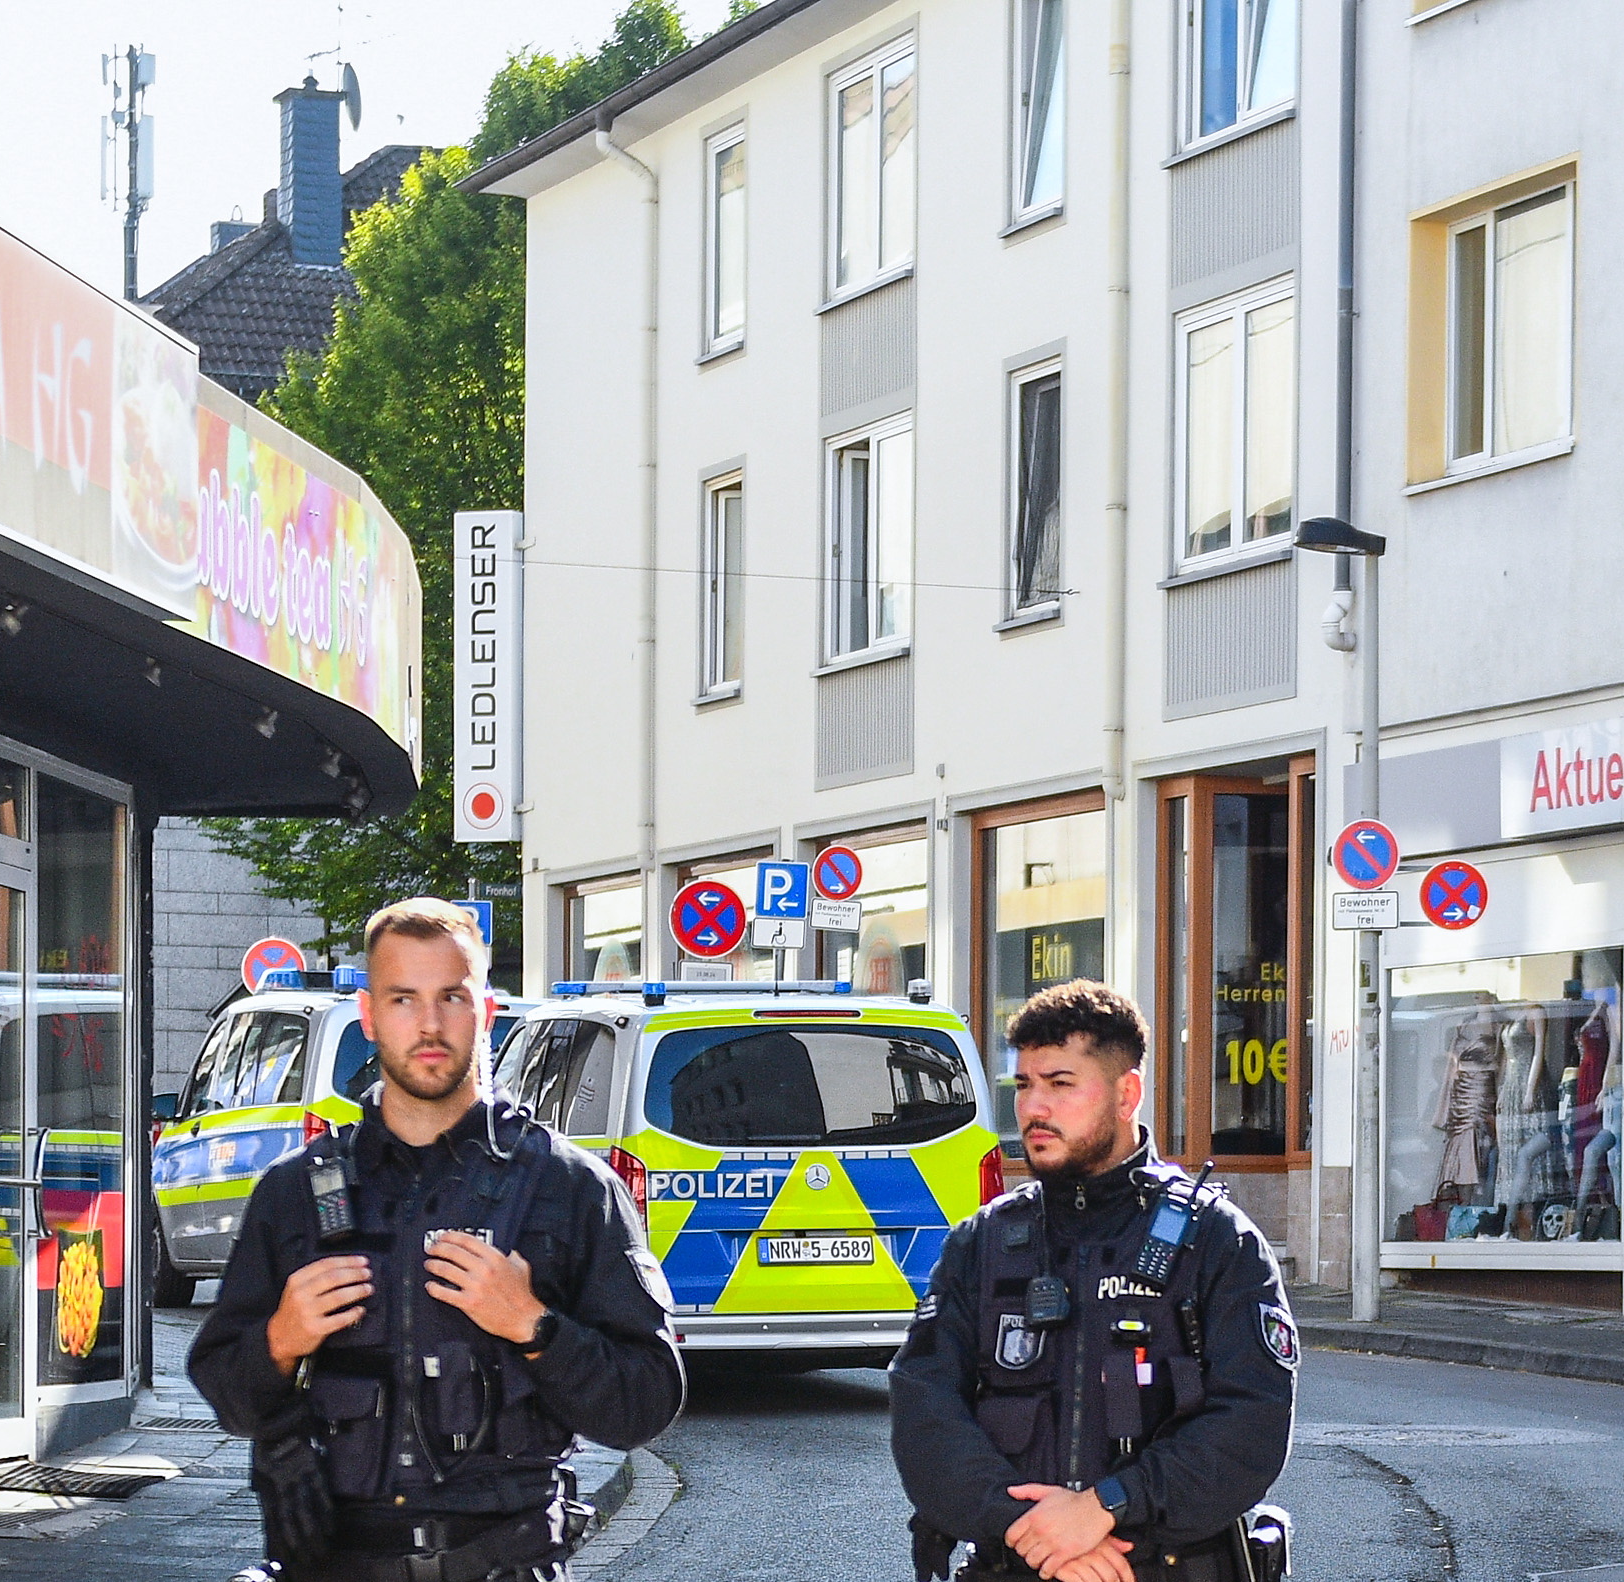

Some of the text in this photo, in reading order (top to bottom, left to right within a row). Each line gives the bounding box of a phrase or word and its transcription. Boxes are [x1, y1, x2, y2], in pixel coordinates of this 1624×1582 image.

[31, 319, 94, 495] HG
[281, 521, 333, 651] tea
[470, 523, 497, 771] LEDLENSER
[485, 885, 517, 897] Fronhof
[763, 868, 793, 911] P
[817, 902, 856, 913] Bewohner
[1339, 897, 1391, 908] Bewohner
[828, 917, 843, 926] frei
[1357, 914, 1375, 924] frei
[1260, 962, 1286, 981] Ek
[1225, 1038, 1288, 1085] 10€
[651, 1172, 773, 1198] POLIZEI
[769, 1239, 871, 1259] NRW 5-6589
[1003, 1315, 1025, 1328] POL
